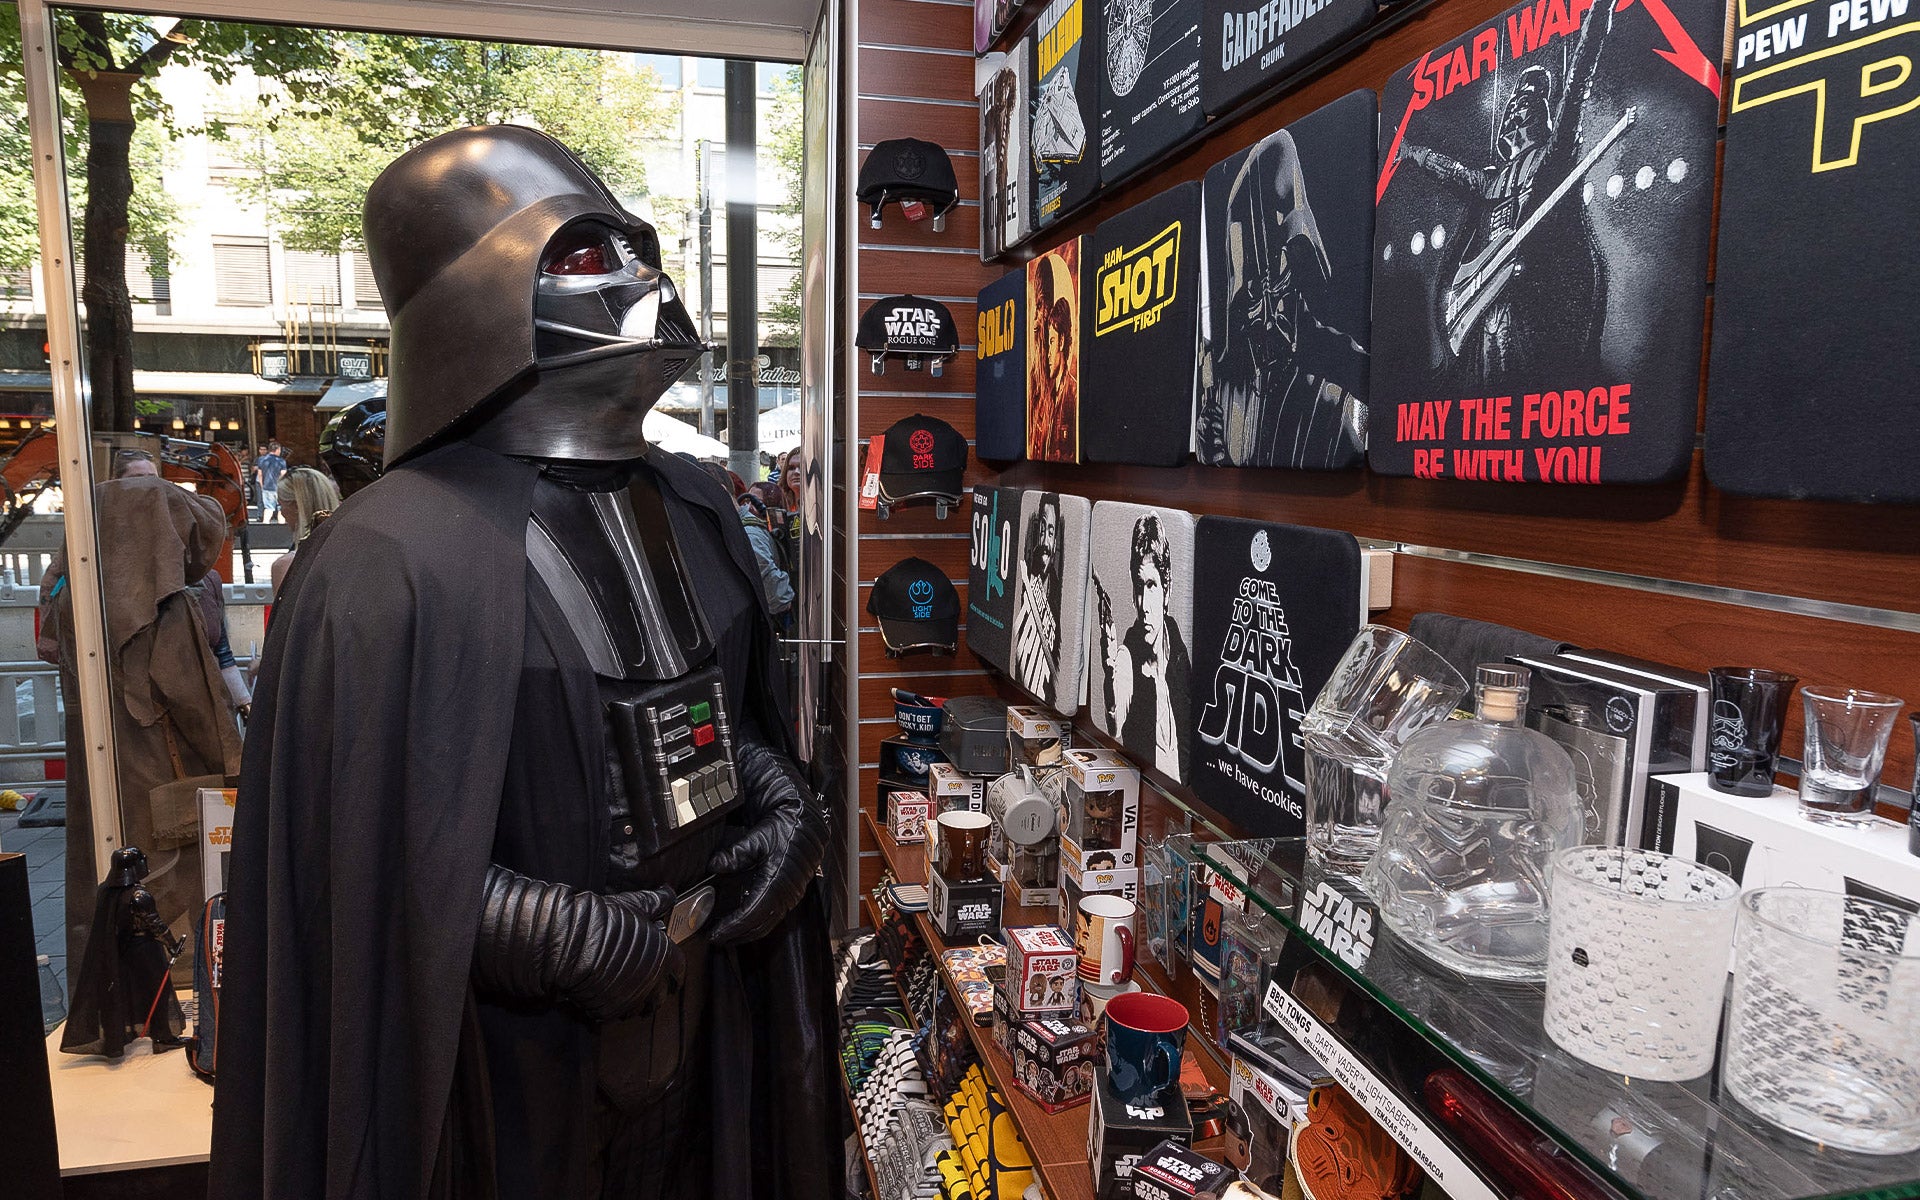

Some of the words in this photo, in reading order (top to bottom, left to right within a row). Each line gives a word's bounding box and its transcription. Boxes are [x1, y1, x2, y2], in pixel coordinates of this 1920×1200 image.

[1736, 13, 1808, 69] PEW
[1827, 0, 1909, 38] PEW
[1260, 42, 1285, 71] CHUNK
[1411, 27, 1498, 110] STAR
[1507, 0, 1594, 59] WAR
[1103, 245, 1123, 269] HAN
[1099, 237, 1175, 325] SHOT
[885, 308, 941, 325] STAR
[1133, 306, 1164, 333] FIRST
[885, 321, 941, 337] WARS
[978, 298, 1015, 360] SOLO
[887, 335, 918, 345] ROGUE
[918, 336, 937, 346] ONE
[1396, 400, 1452, 442] MAY
[1459, 396, 1512, 441] THE
[1521, 383, 1631, 440] FORCE
[913, 453, 934, 461] DARK
[913, 461, 935, 469] SIDE
[1413, 448, 1446, 480] BE
[1453, 449, 1526, 483] WITH
[1534, 447, 1602, 485] YOU
[1239, 576, 1281, 605] COME
[912, 605, 933, 613] LIGHT
[1232, 598, 1253, 625] TO
[1257, 603, 1290, 636] THE
[1221, 623, 1303, 689] DARK
[898, 711, 916, 722] DON'T
[916, 715, 932, 724] GET
[1198, 663, 1306, 795] SIDE
[971, 782, 982, 799] RIO
[1218, 757, 1233, 777] we
[1235, 766, 1260, 796] have
[1261, 786, 1303, 821] cookies
[1124, 804, 1137, 834] VAL
[208, 826, 233, 836] ST
[1125, 882, 1136, 904] HA
[1214, 877, 1236, 902] WARS
[957, 903, 991, 913] STAR
[957, 911, 992, 920] WARS
[1303, 882, 1375, 946] STAR
[1299, 899, 1372, 970] WARS
[1032, 958, 1060, 966] STAR
[1270, 987, 1285, 1010] BBQ
[1286, 1003, 1312, 1033] TONGS
[1315, 1033, 1338, 1056] DARTH
[1018, 1029, 1038, 1049] STAR
[1018, 1036, 1038, 1054] WARS
[1056, 1053, 1080, 1064] WARS
[1057, 1046, 1080, 1058] STAR
[1256, 1077, 1274, 1098] STAR
[1256, 1083, 1274, 1104] WARS
[1170, 1134, 1186, 1142] Disney
[1349, 1082, 1356, 1093] DA
[1356, 1088, 1368, 1104] BBQ
[1374, 1106, 1398, 1133] TENAZAS
[1398, 1131, 1412, 1150] PARA
[1413, 1146, 1445, 1181] BARBACOA
[1166, 1142, 1183, 1154] Disney
[1115, 1155, 1143, 1166] ST
[1157, 1160, 1204, 1182] WARS
[1158, 1156, 1204, 1177] STAR
[1135, 1180, 1170, 1200] STAR
